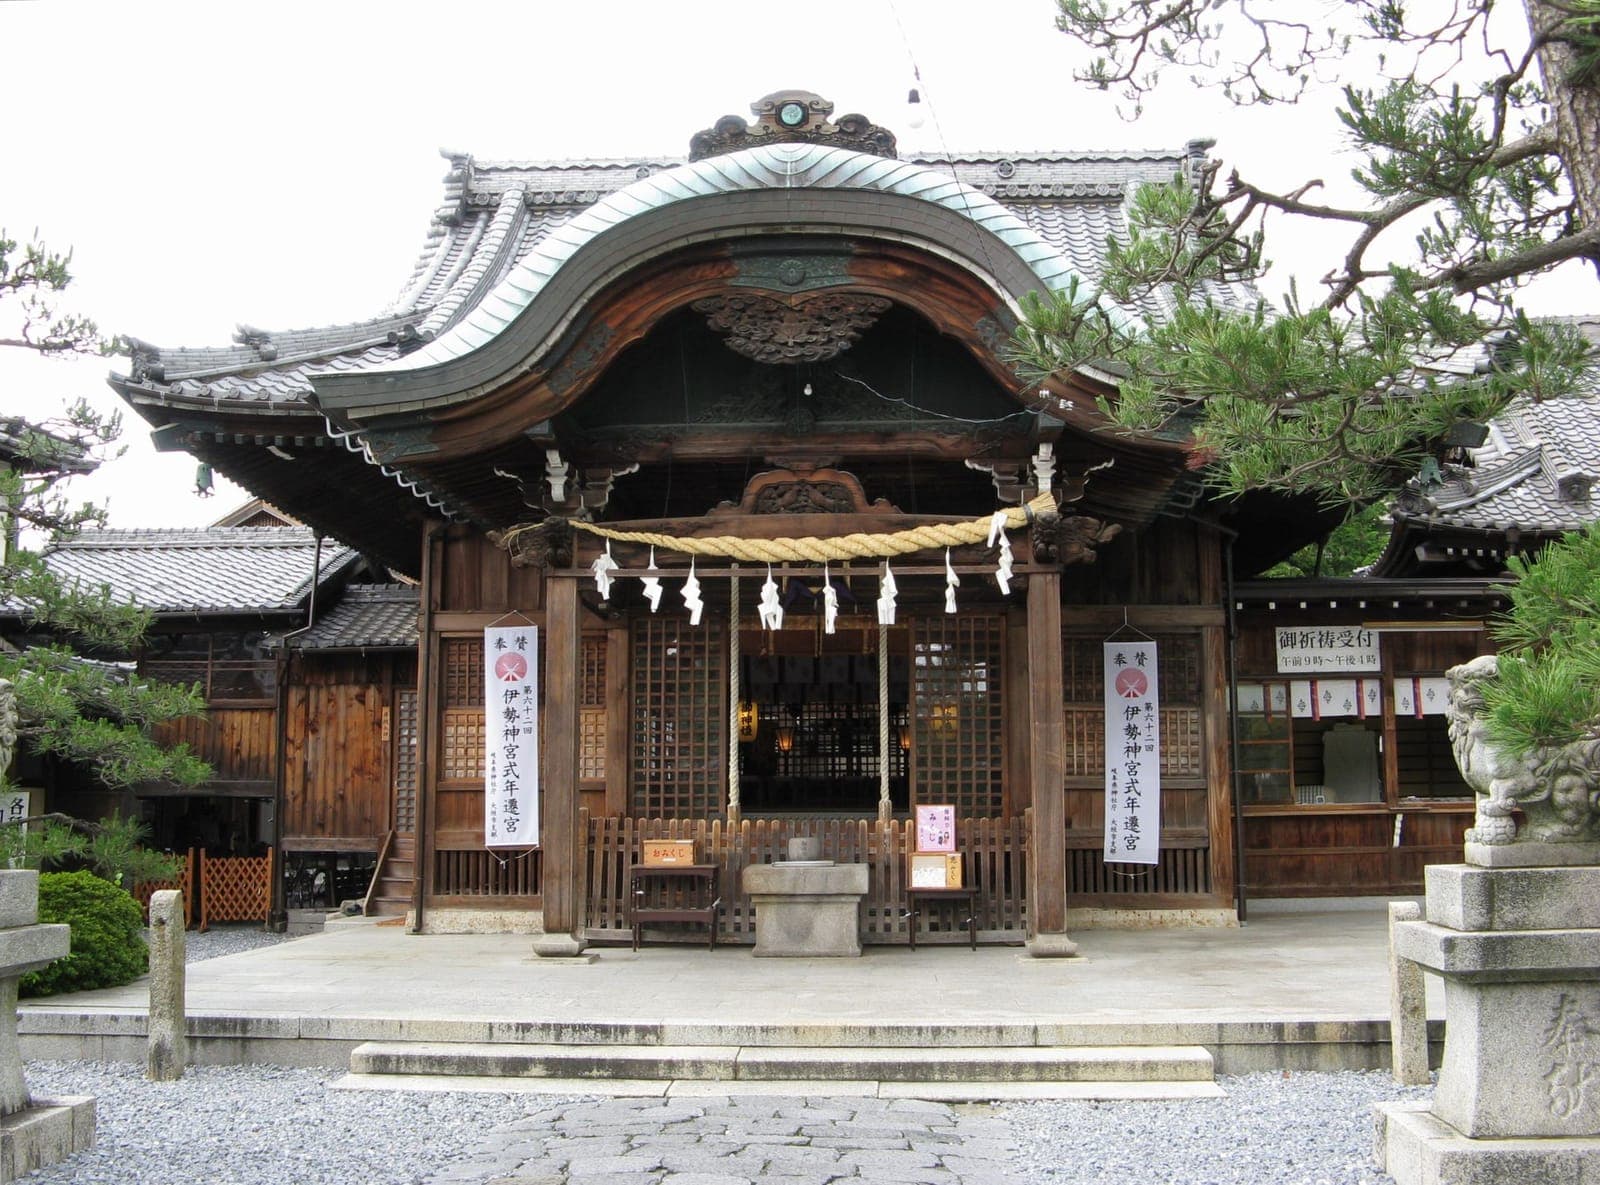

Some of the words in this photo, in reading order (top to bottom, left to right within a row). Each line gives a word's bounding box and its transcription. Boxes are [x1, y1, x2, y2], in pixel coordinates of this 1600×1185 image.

[1279, 630, 1373, 650] 御祈祷受付
[522, 685, 533, 735] 第六十二回
[1143, 702, 1155, 753] 第六十二回
[502, 688, 521, 834] 伊勢神宮式年遷宮
[1122, 705, 1142, 851] 伊勢神宮式年遷宮
[652, 848, 685, 858] おみくじ
